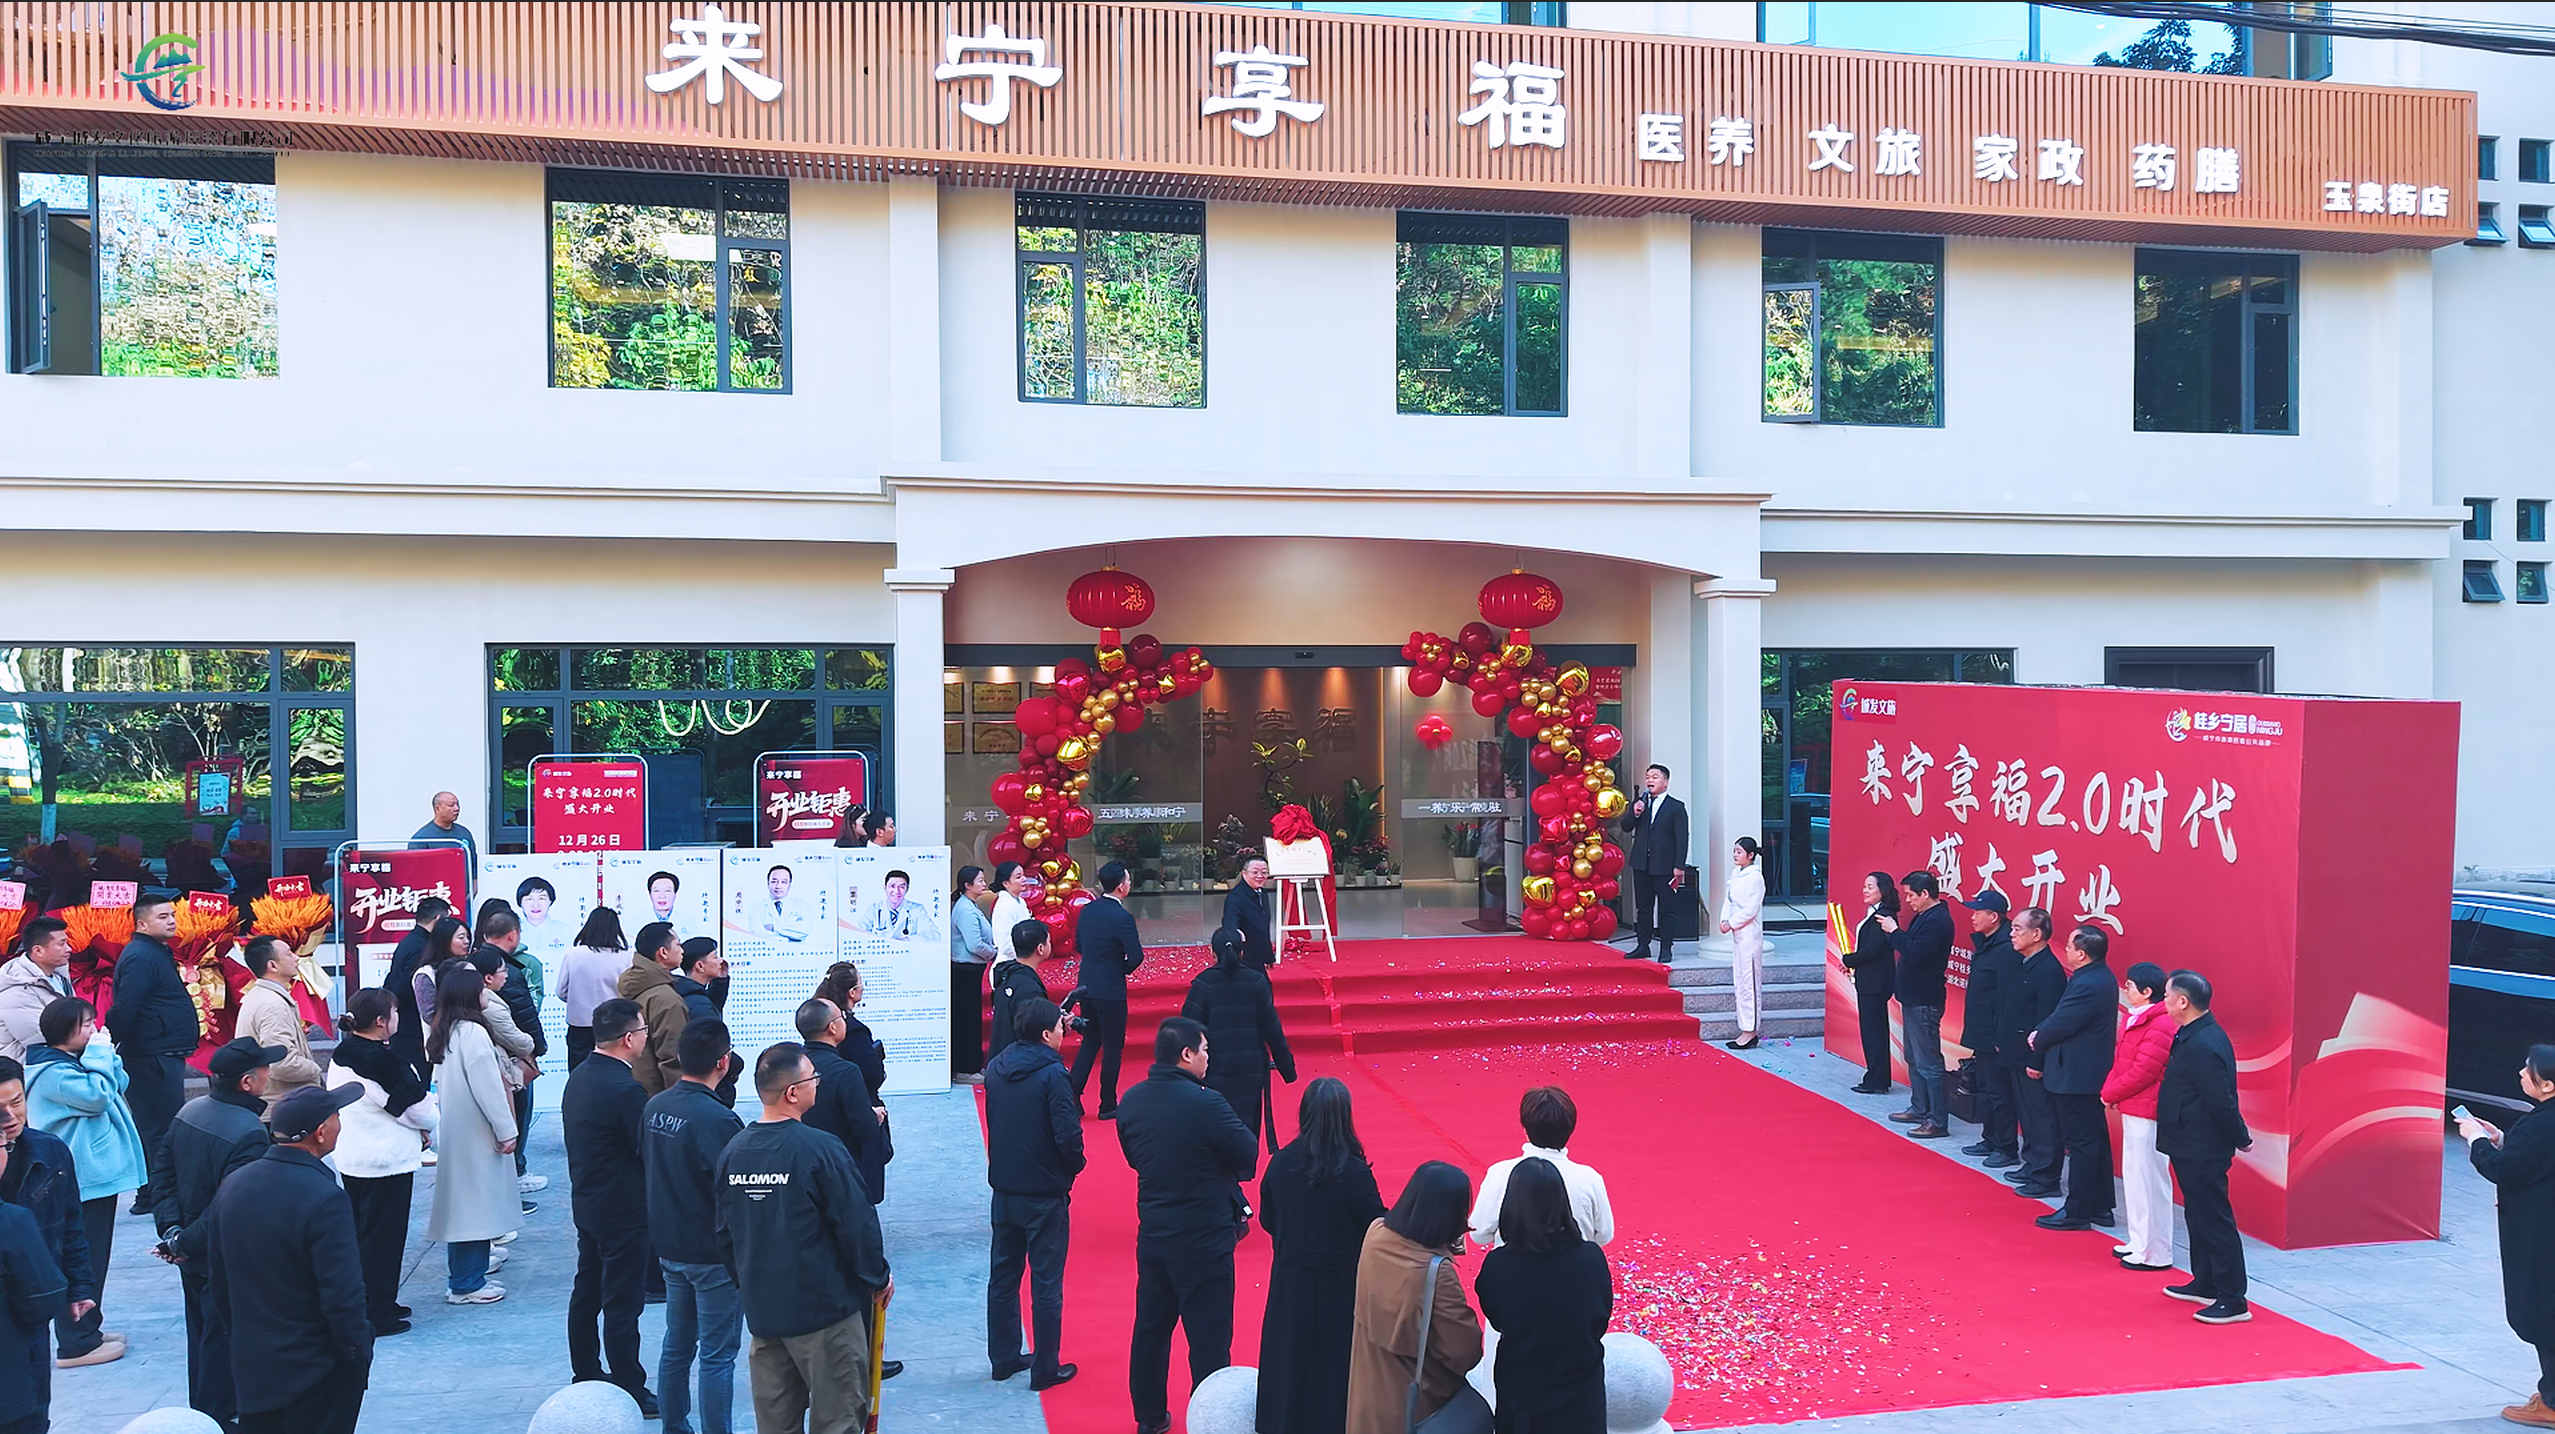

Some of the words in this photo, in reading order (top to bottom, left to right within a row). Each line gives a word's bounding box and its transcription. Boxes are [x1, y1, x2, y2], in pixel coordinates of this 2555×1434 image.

[645, 4, 1566, 149] 来宁享福
[1637, 112, 1756, 167] 医养
[1808, 124, 1924, 178] 文旅
[1973, 133, 2086, 188] 家政
[2131, 142, 2242, 195] 药膳
[2323, 180, 2450, 218] 玉泉街店
[1860, 697, 1897, 716] 城发文旅
[2193, 711, 2248, 734] 桂乡宁居
[542, 785, 638, 800] 来宁享福2.0时代
[1859, 738, 2238, 865] 来宁享福2.0时代
[563, 802, 616, 816] 盛大开业
[558, 833, 621, 847] 12月26日
[1926, 831, 2124, 936] 盛大开业
[646, 1111, 688, 1133] ASPW
[728, 1172, 790, 1186] SALOMON
